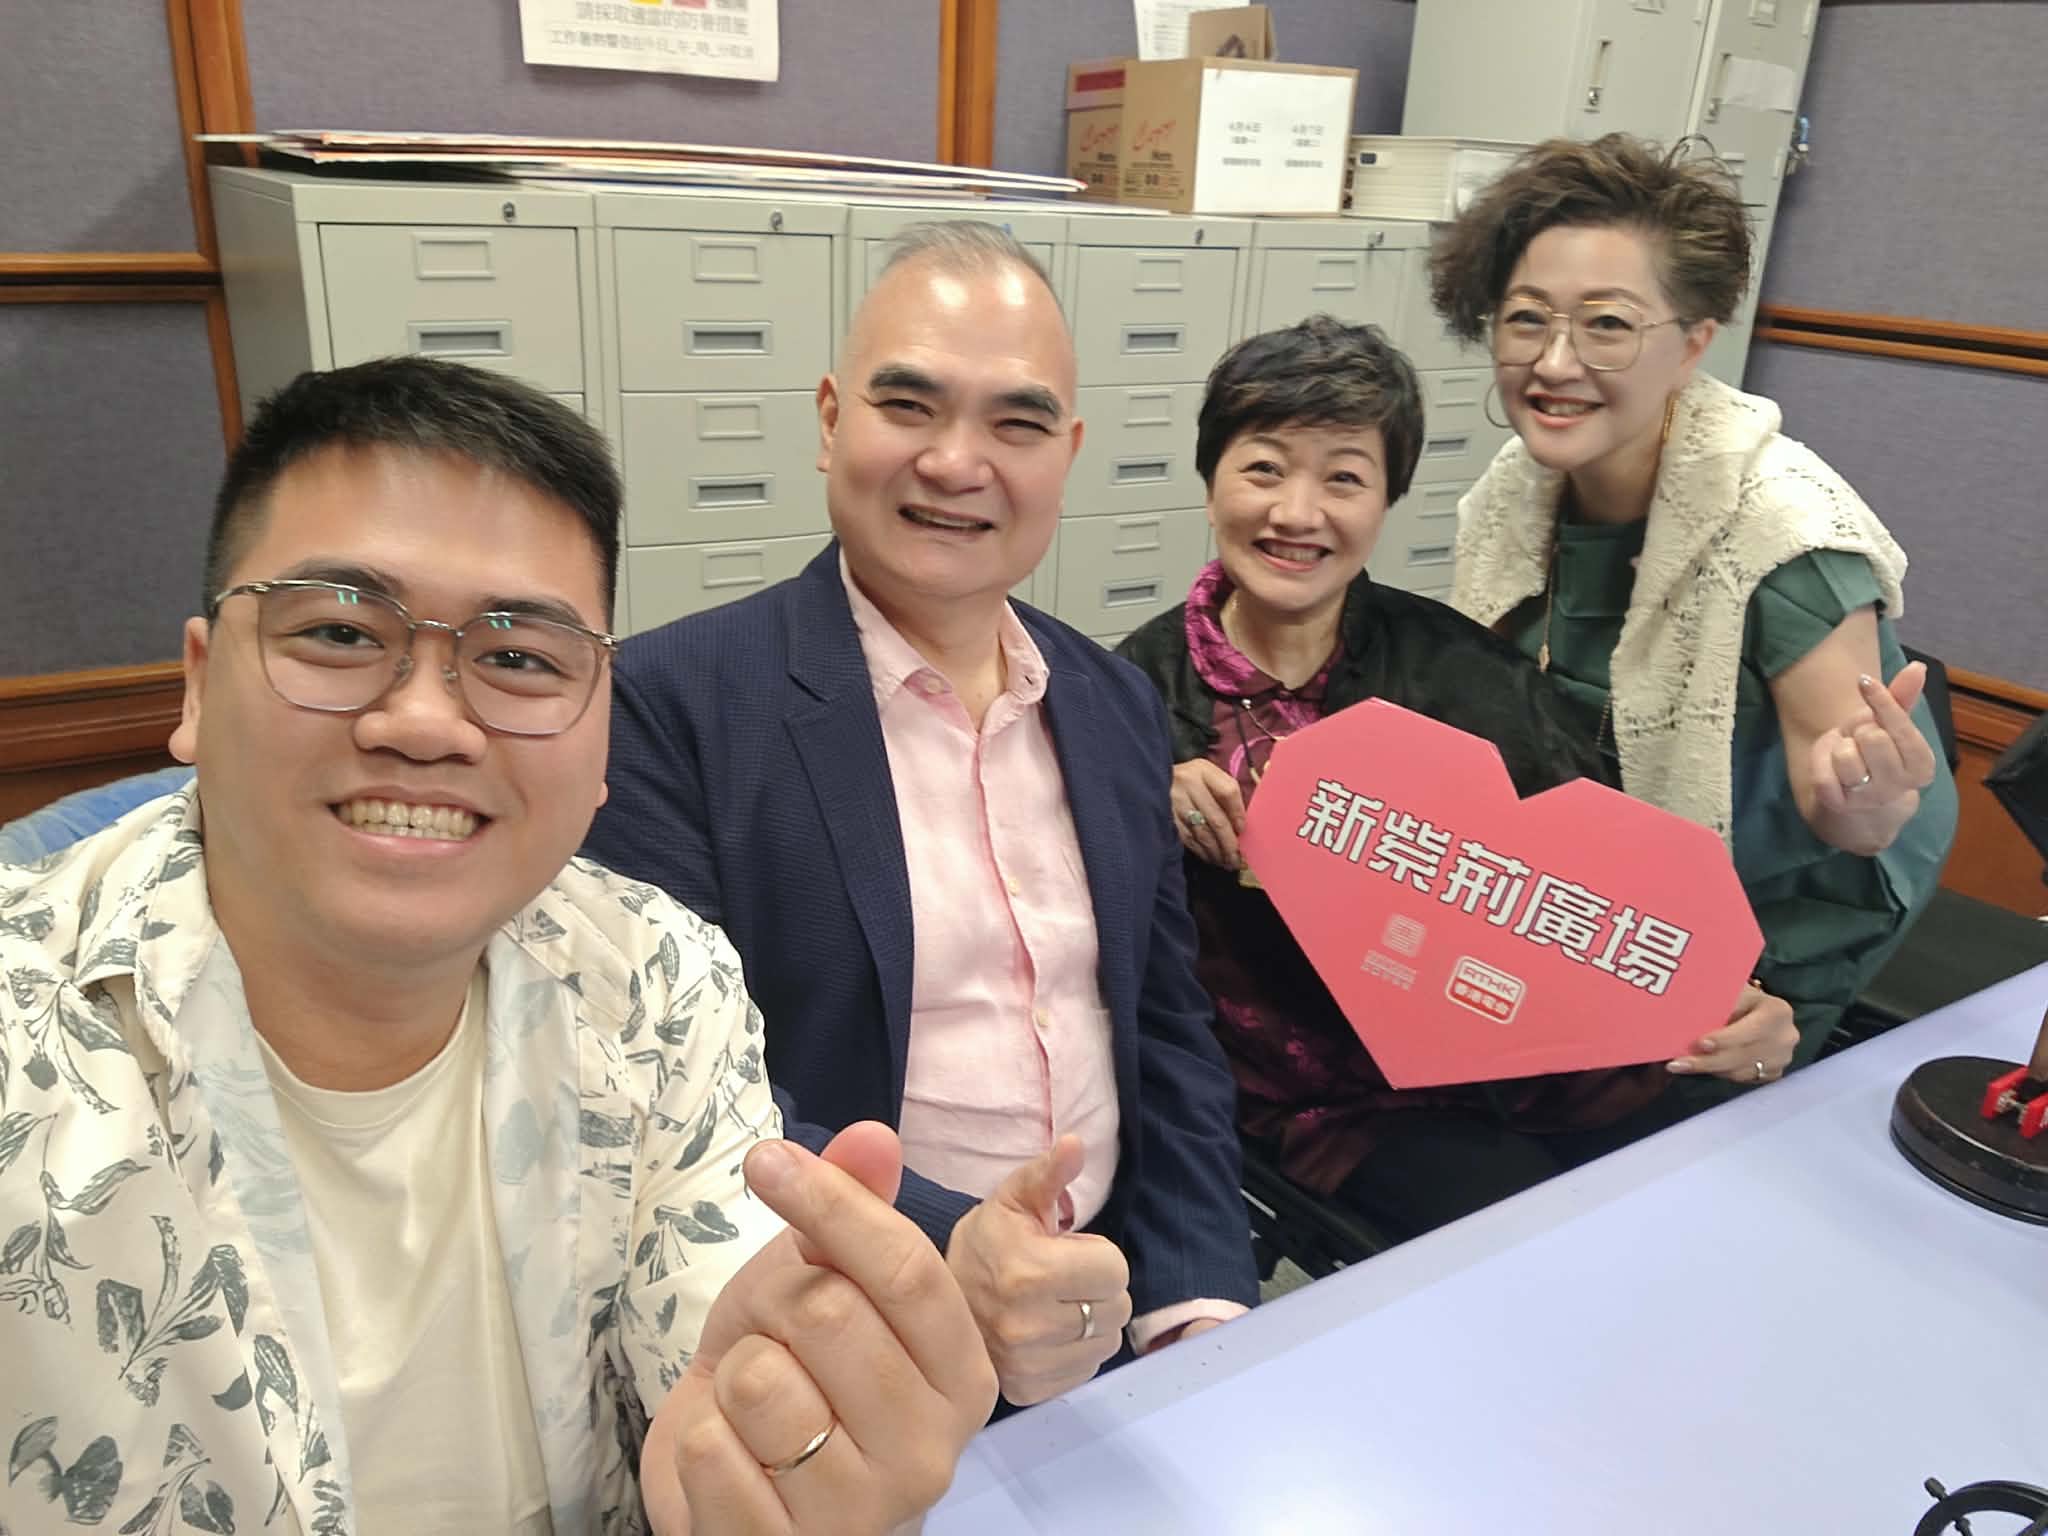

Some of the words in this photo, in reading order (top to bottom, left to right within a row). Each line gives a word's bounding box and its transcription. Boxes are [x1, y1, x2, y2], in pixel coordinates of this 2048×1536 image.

[1296, 779, 1692, 996] 新紫荊廣場
[1463, 966, 1517, 999] RTHK
